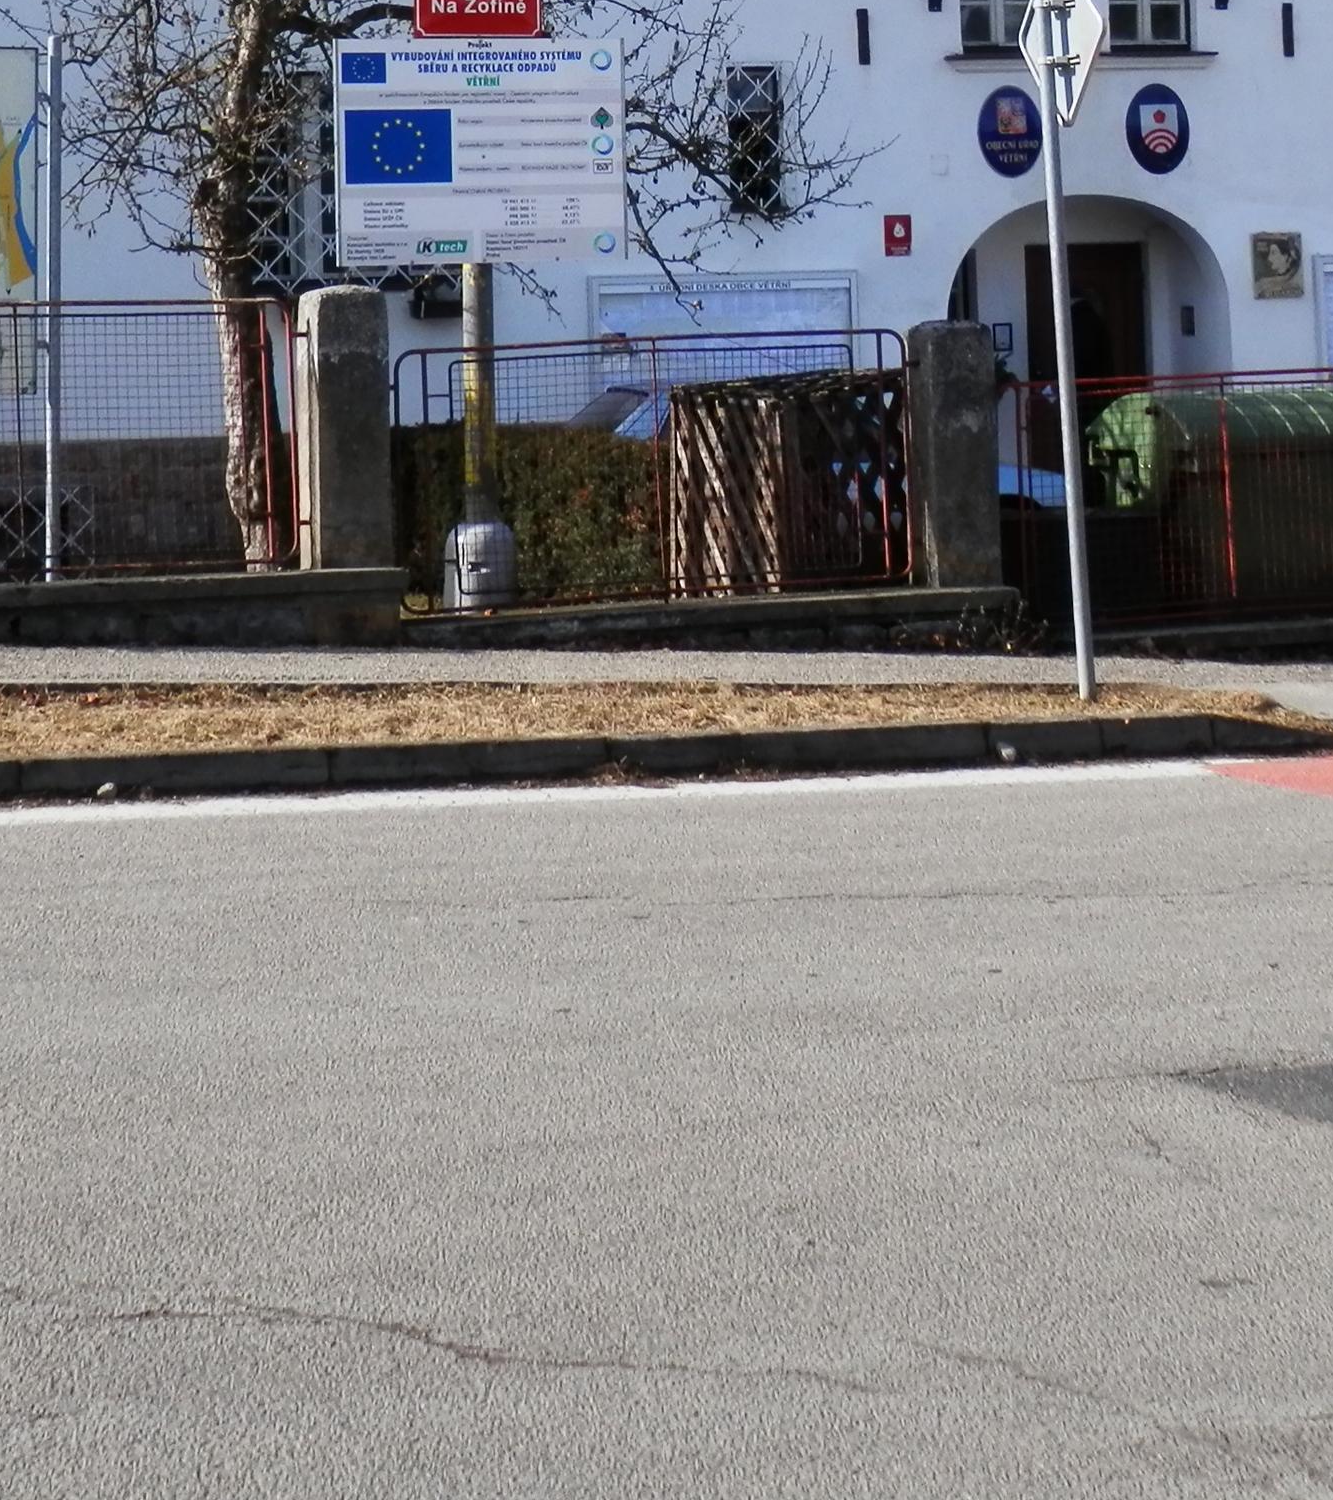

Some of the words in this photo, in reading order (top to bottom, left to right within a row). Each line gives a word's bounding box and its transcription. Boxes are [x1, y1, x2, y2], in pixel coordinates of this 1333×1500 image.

[467, 41, 493, 50] Projekt
[390, 49, 454, 61] VYBUDOVÁNÍ
[457, 49, 537, 60] INTEGROVANÉHO
[539, 48, 582, 60] SYSTÉMU
[418, 62, 448, 74] SBĚRU
[452, 63, 458, 73] A
[462, 63, 514, 73] RECYKLACE
[517, 61, 557, 73] ODPADŮ
[466, 75, 500, 87] VĚTŘNÍ
[439, 241, 464, 252] tech
